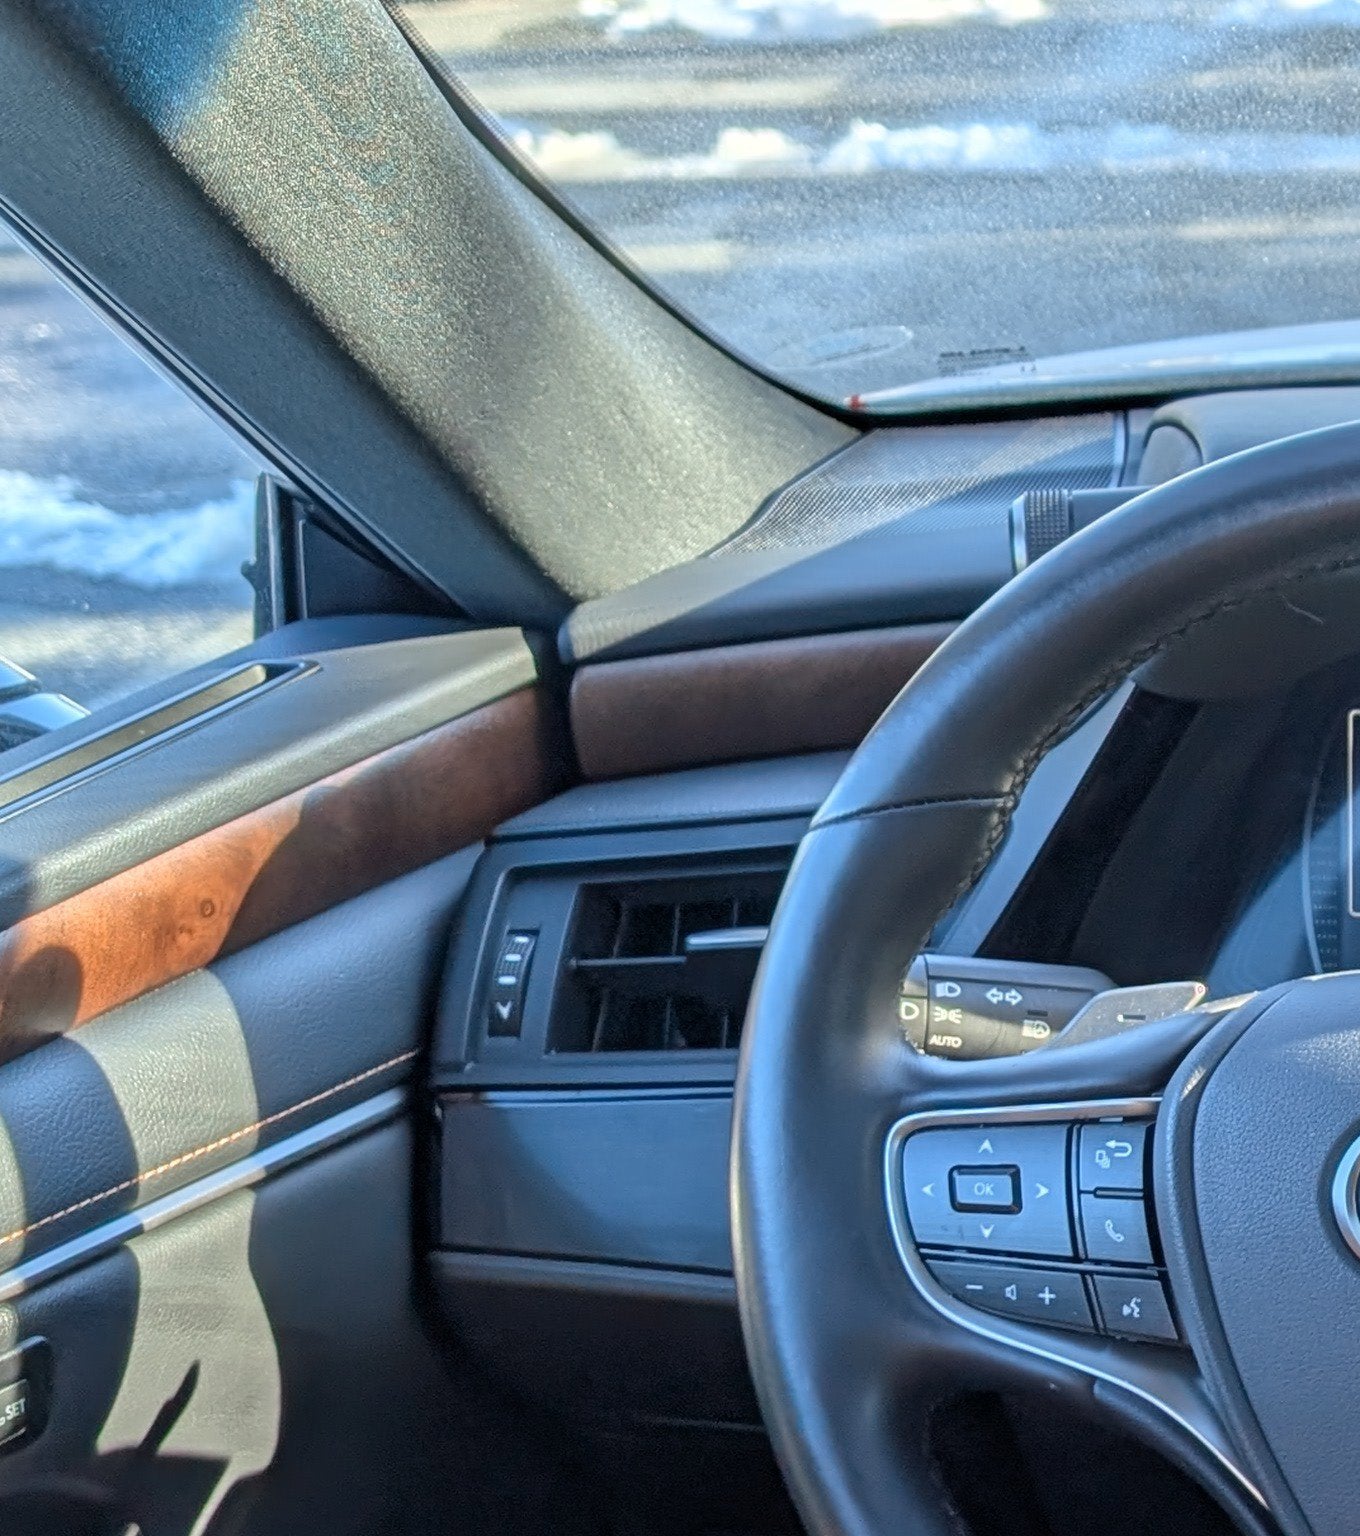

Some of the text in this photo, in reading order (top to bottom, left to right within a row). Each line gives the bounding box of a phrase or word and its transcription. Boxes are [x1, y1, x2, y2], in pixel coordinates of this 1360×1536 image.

[928, 1033, 963, 1049] AUTO
[973, 1182, 996, 1197] OK
[4, 1398, 26, 1420] SET
